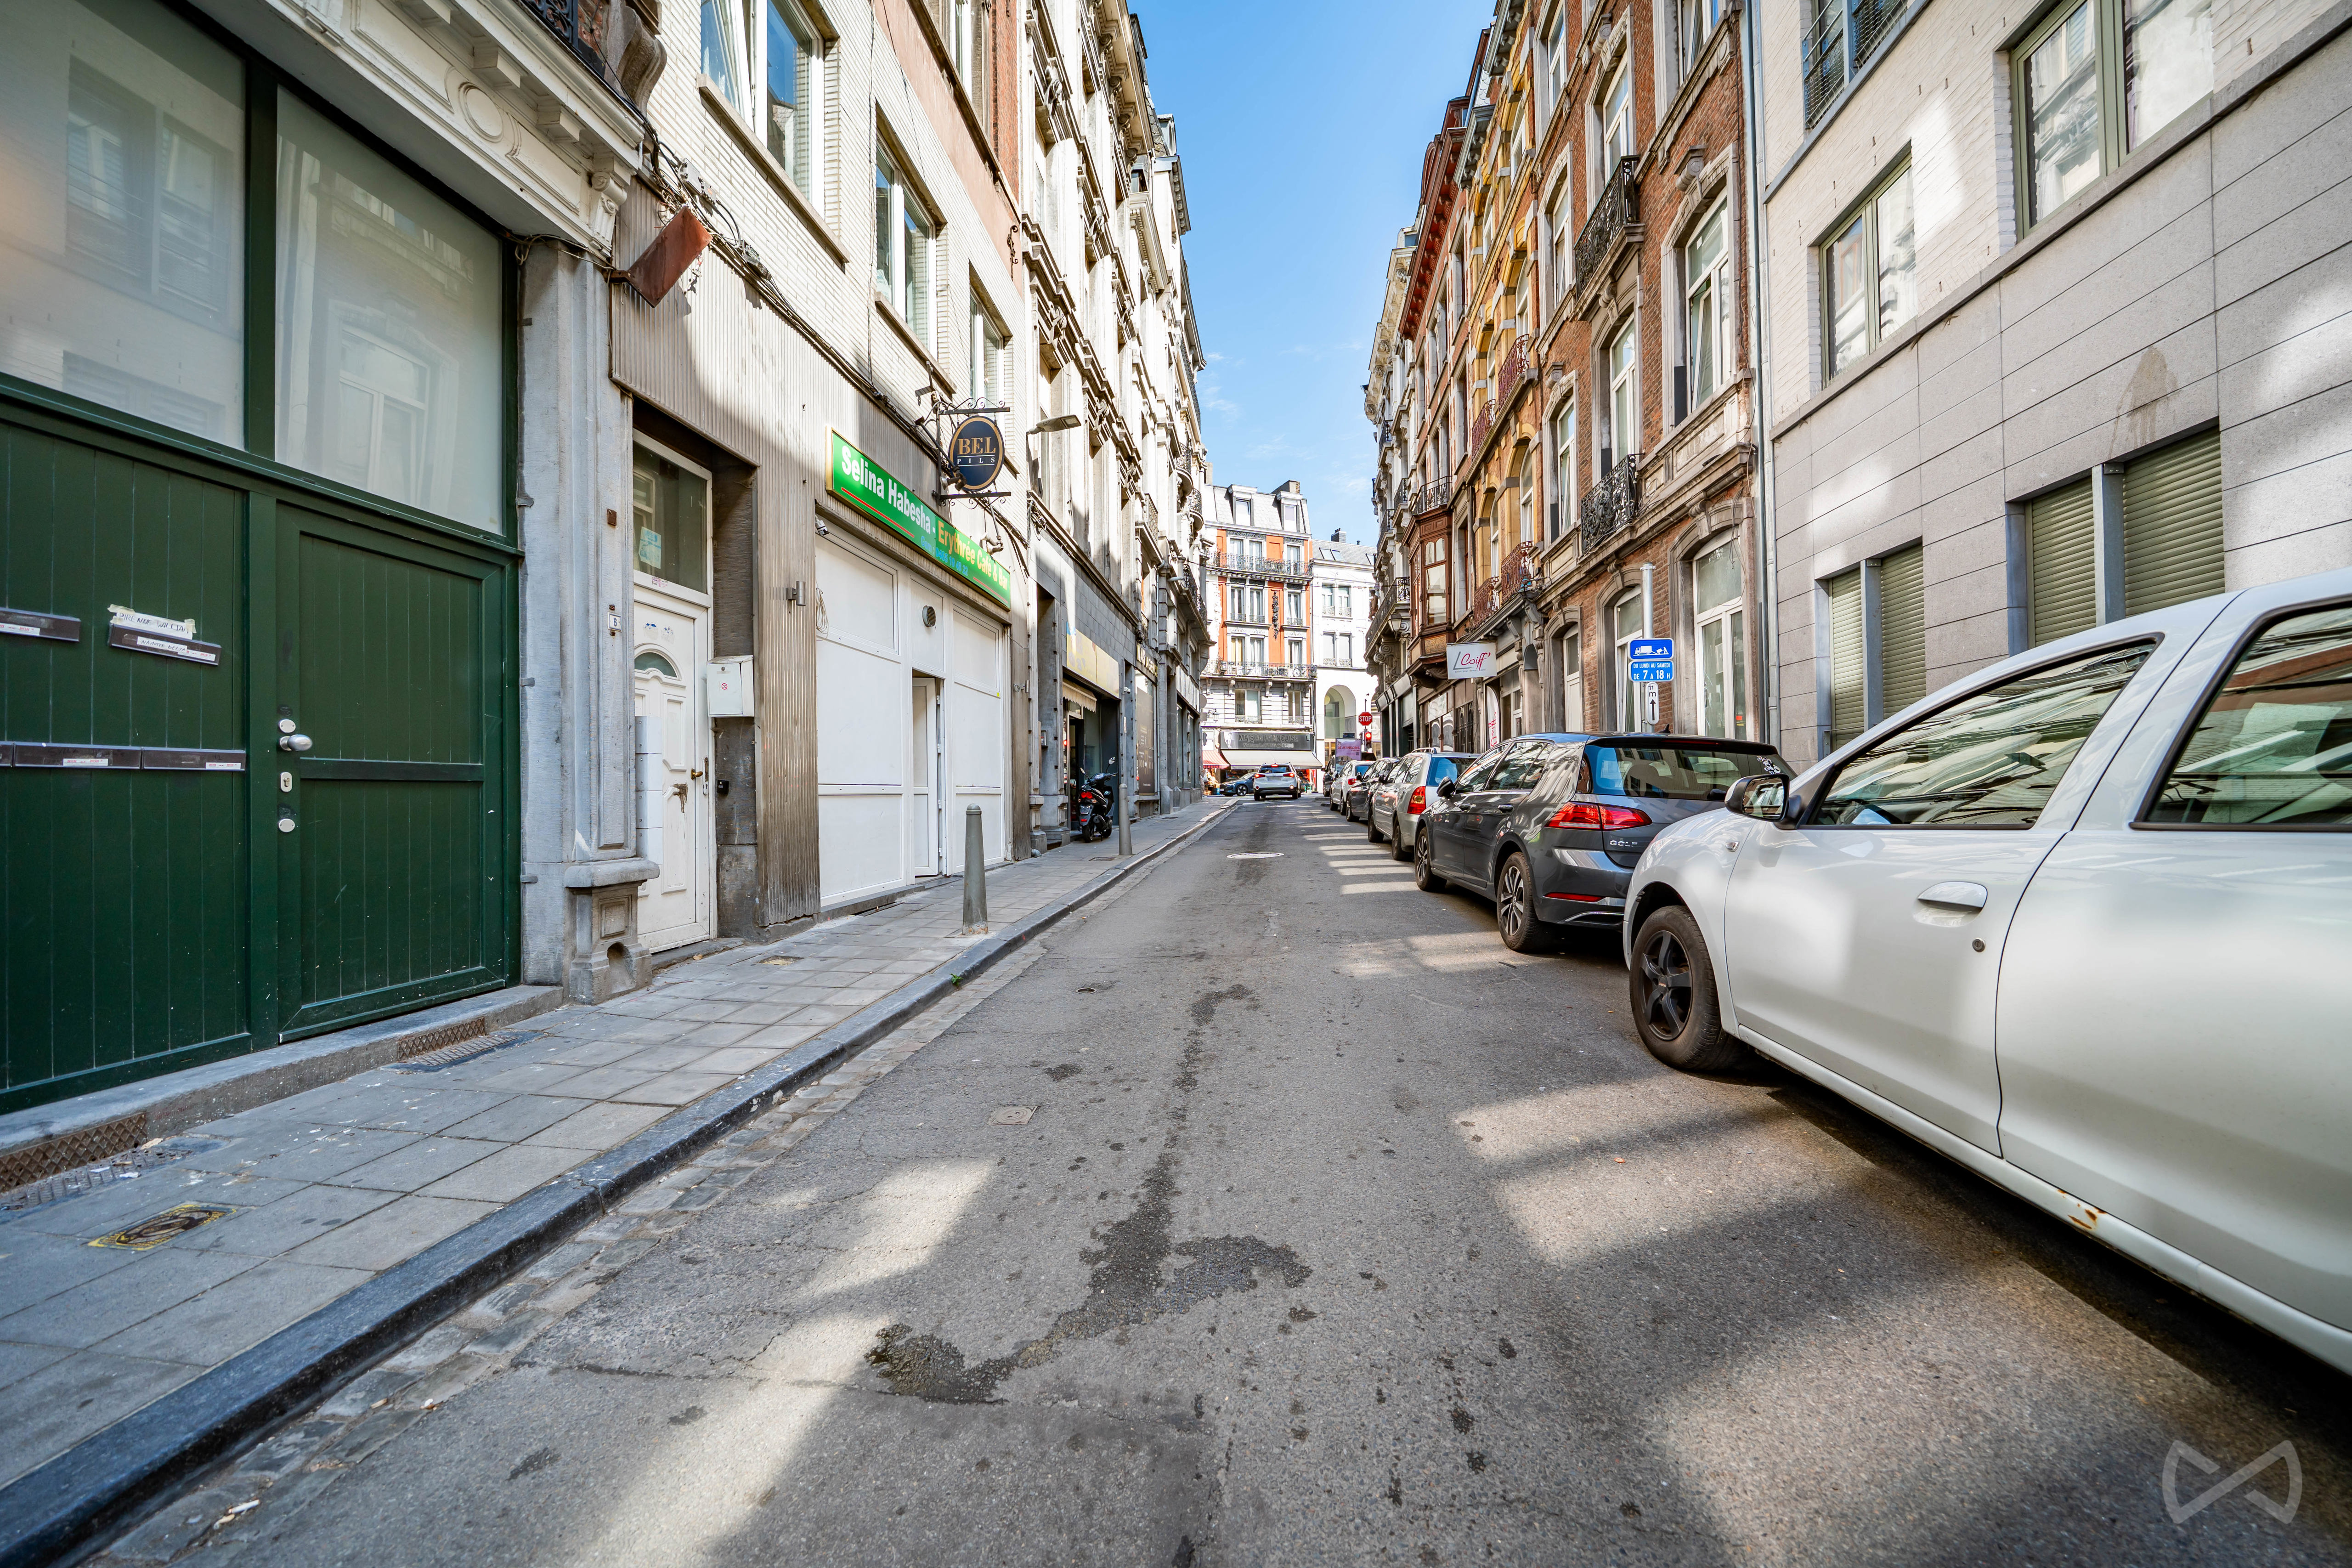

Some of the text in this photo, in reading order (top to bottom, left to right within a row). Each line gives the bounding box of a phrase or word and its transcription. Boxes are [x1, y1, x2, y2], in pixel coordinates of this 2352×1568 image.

[957, 437, 996, 455] BEL
[842, 446, 884, 499] Selina
[888, 478, 931, 534] Habesha
[938, 520, 975, 565] Erythrée
[977, 549, 992, 577] Café
[993, 563, 997, 582] &
[999, 568, 1008, 590] Bar
[962, 564, 968, 576] 22
[614, 618, 617, 627] 6
[1643, 670, 1648, 679] 7
[1656, 670, 1664, 679] 18
